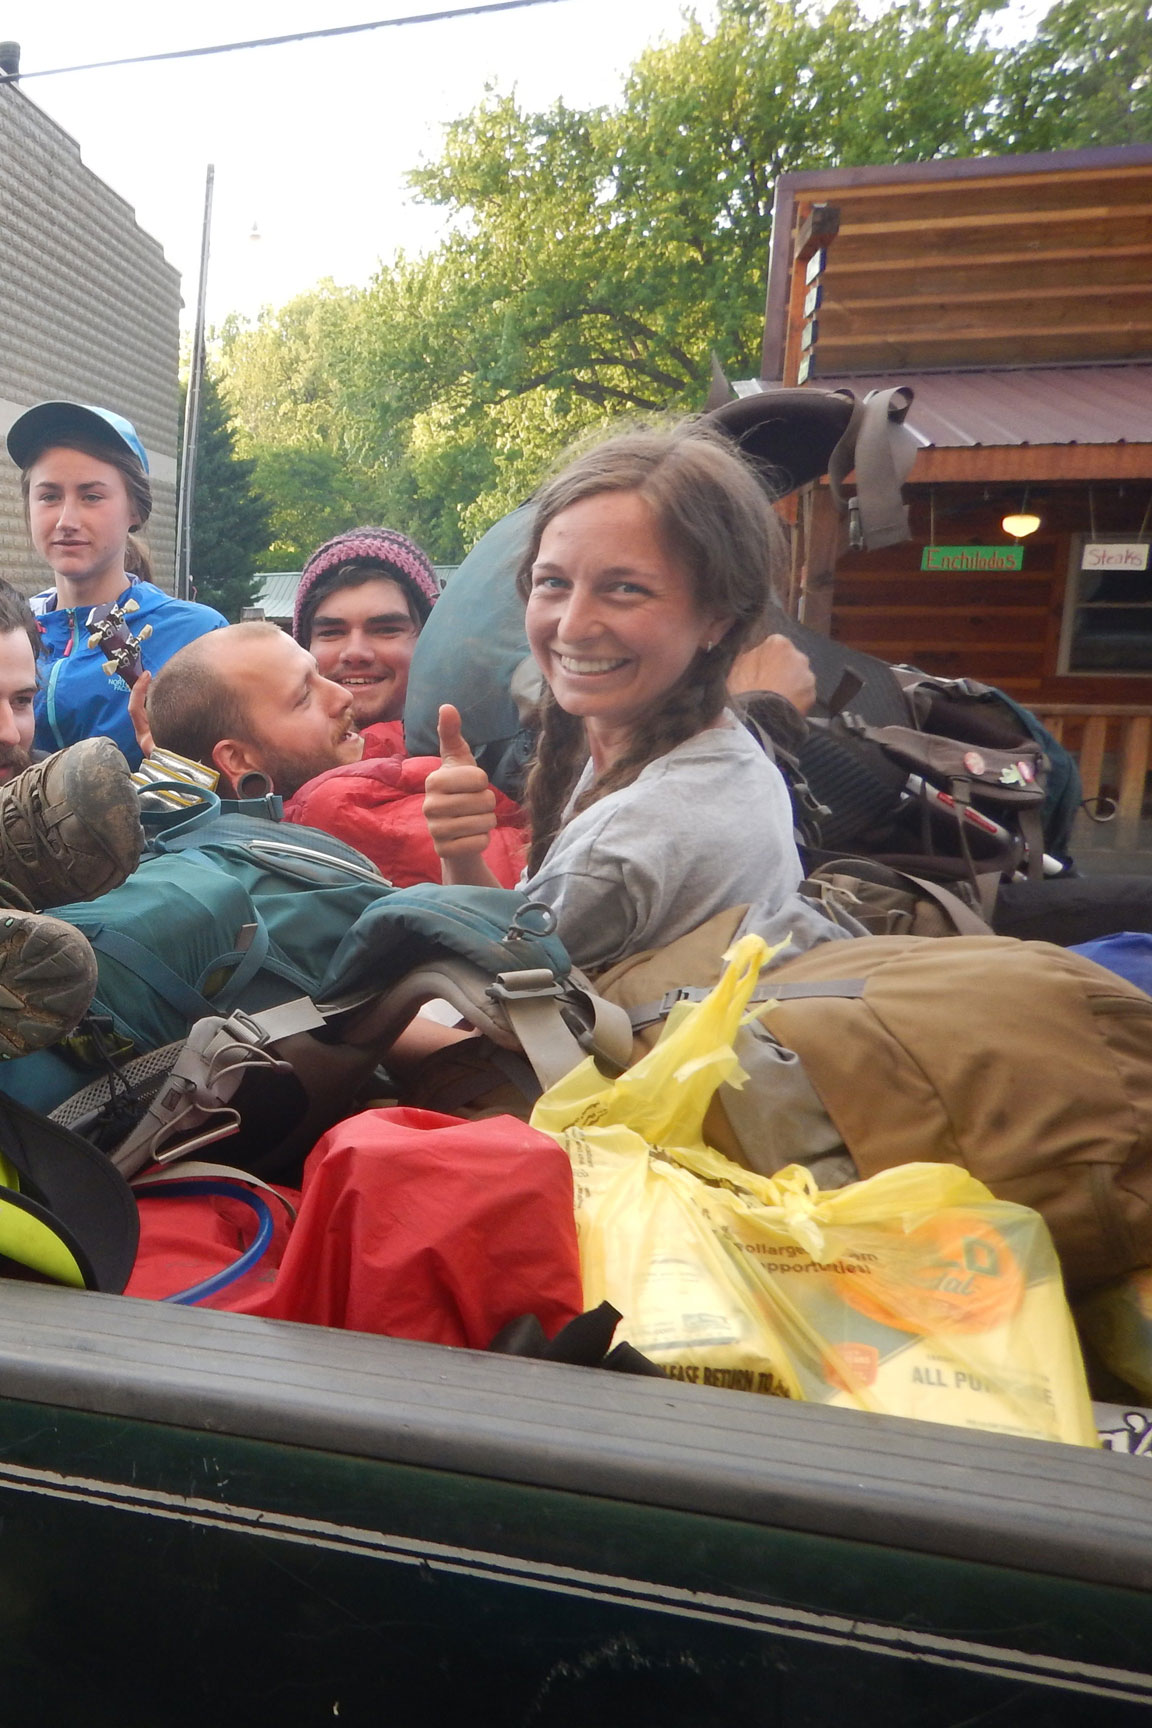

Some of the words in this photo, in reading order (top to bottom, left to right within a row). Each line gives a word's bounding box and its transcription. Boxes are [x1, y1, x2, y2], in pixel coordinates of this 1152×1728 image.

[1086, 549, 1144, 567] Steaks
[659, 1363, 700, 1385] LEASE
[703, 1366, 754, 1393] RETURN
[912, 1366, 948, 1388] ALL
